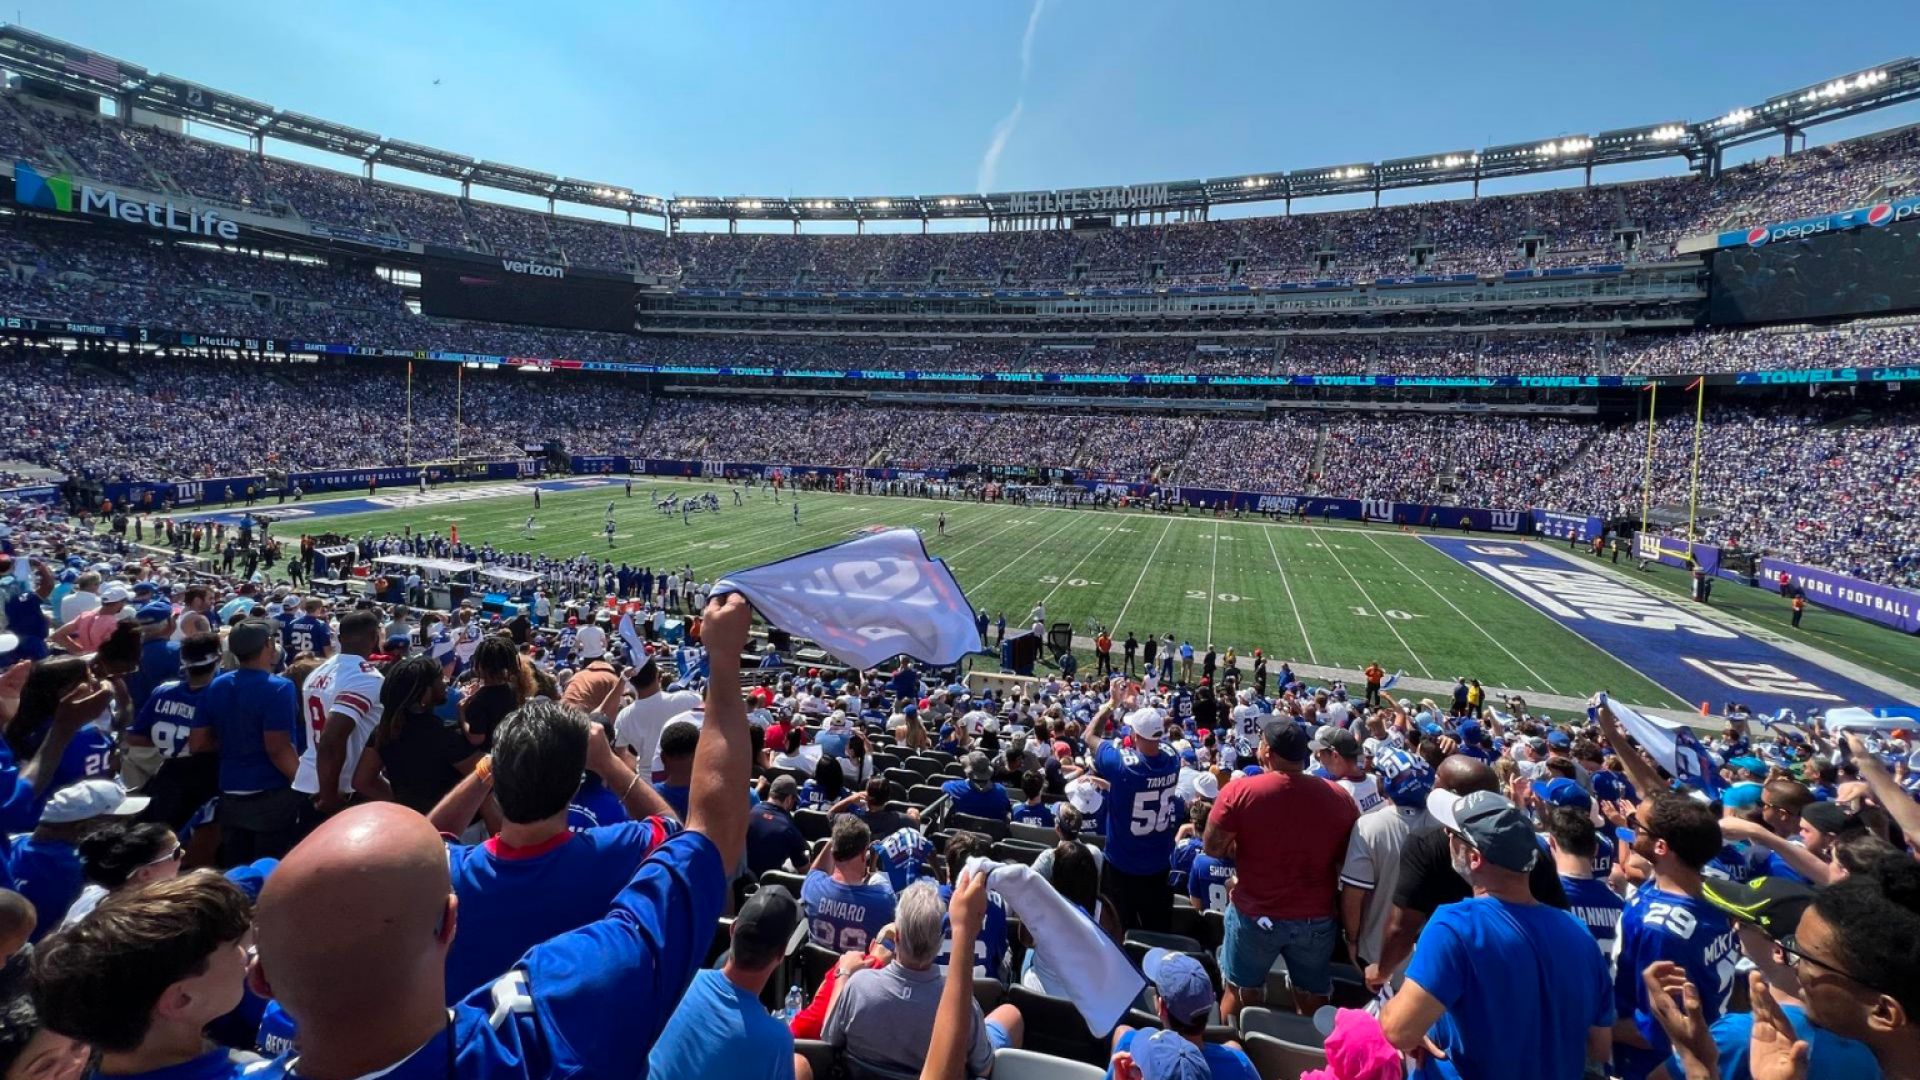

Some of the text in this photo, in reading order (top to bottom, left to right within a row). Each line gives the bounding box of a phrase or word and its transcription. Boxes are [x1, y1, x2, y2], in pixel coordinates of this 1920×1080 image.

[1010, 184, 1168, 214] METLIFE STADIUM
[80, 185, 239, 240] MetLife
[1772, 218, 1830, 242] pepsi
[503, 259, 564, 279] verizon
[66, 323, 147, 342] PANTHERS 3
[200, 336, 241, 347] MetLife
[266, 340, 274, 351] 6
[730, 367, 775, 376] TOWELS
[861, 370, 905, 379] TOWELS
[995, 373, 1043, 382] TOWELS
[1144, 375, 1197, 384] TOWELS
[1757, 368, 1858, 384] TOWELS
[1312, 376, 1376, 385] TOWELS
[1518, 376, 1599, 387] TOWELS
[321, 475, 347, 485] YORK
[1798, 576, 1833, 596] YORK
[1838, 587, 1911, 618] FOOTBALL
[1348, 606, 1413, 620] 10
[291, 632, 314, 651] 26
[560, 634, 576, 648] 26
[1146, 773, 1177, 789] TAYLOR
[884, 830, 928, 859] BLUE
[818, 898, 866, 923] BAVARO
[1643, 902, 1697, 940] 29
